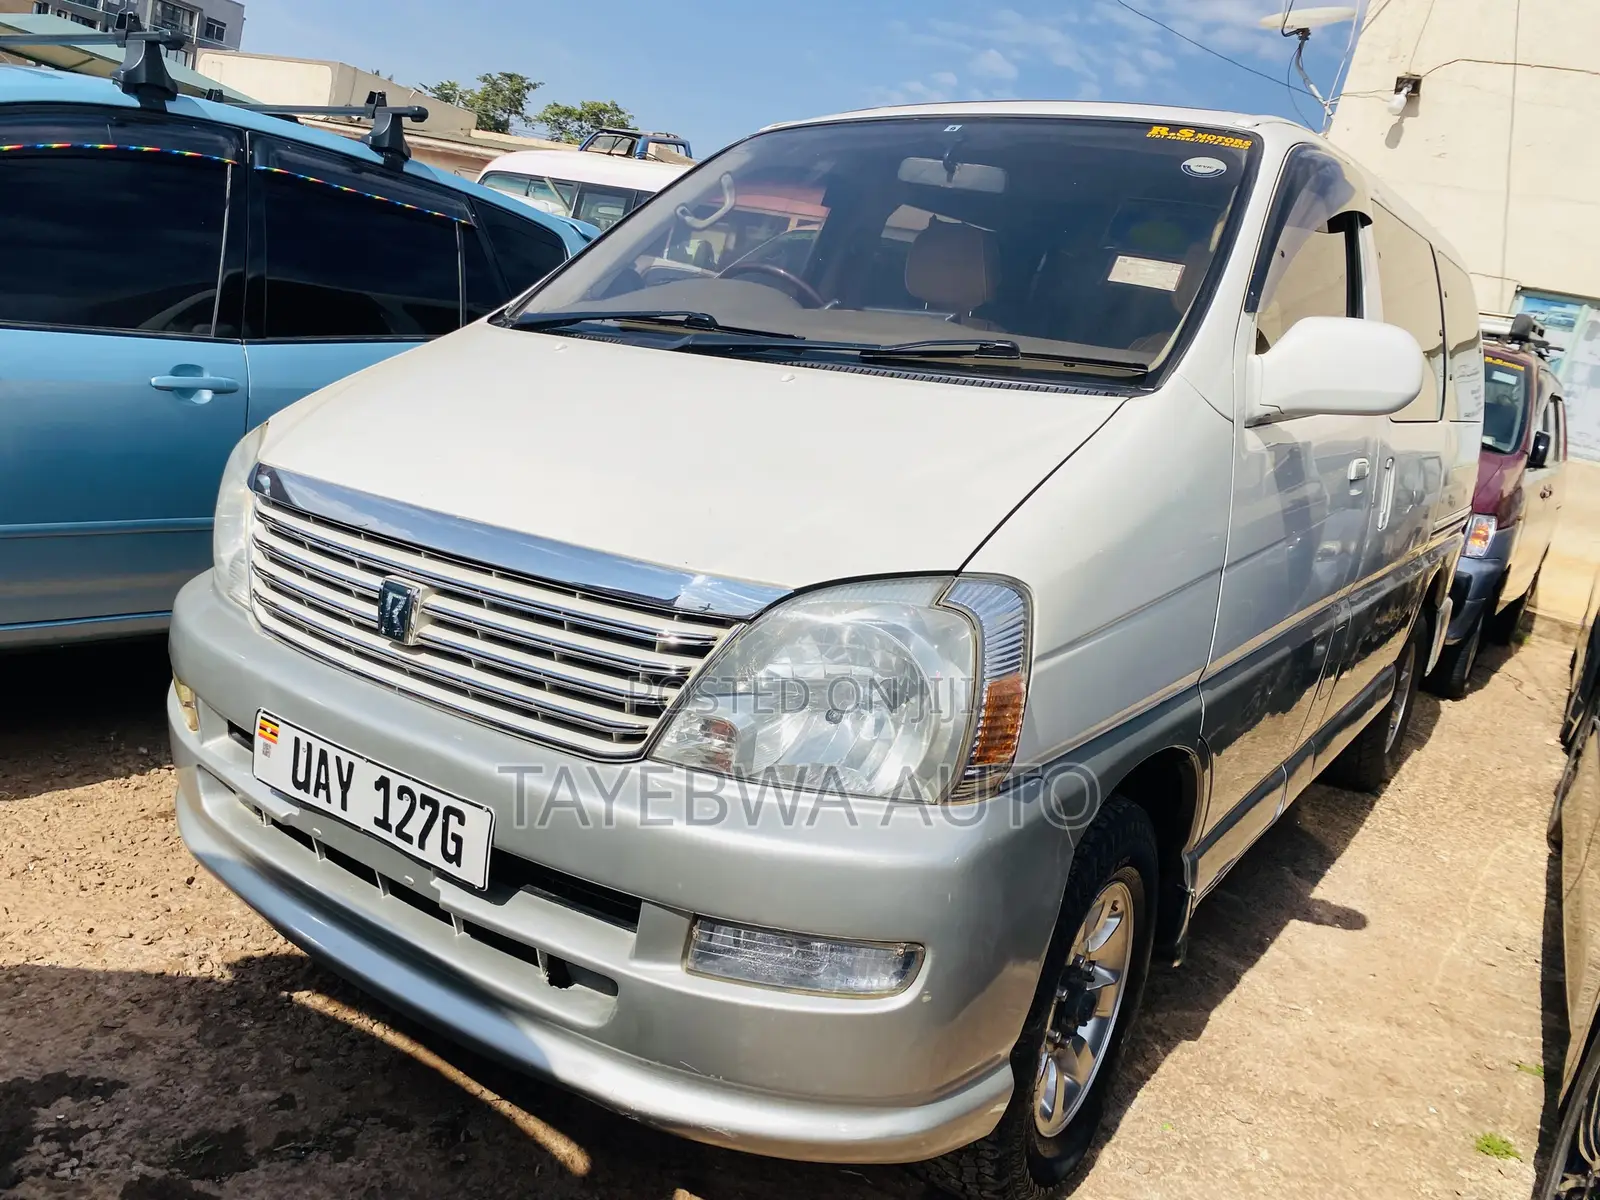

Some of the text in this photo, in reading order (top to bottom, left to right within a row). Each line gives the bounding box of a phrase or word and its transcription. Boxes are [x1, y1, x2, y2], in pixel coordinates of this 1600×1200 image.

[1196, 133, 1252, 146] MOTORS
[292, 736, 466, 867] UAY 127G
